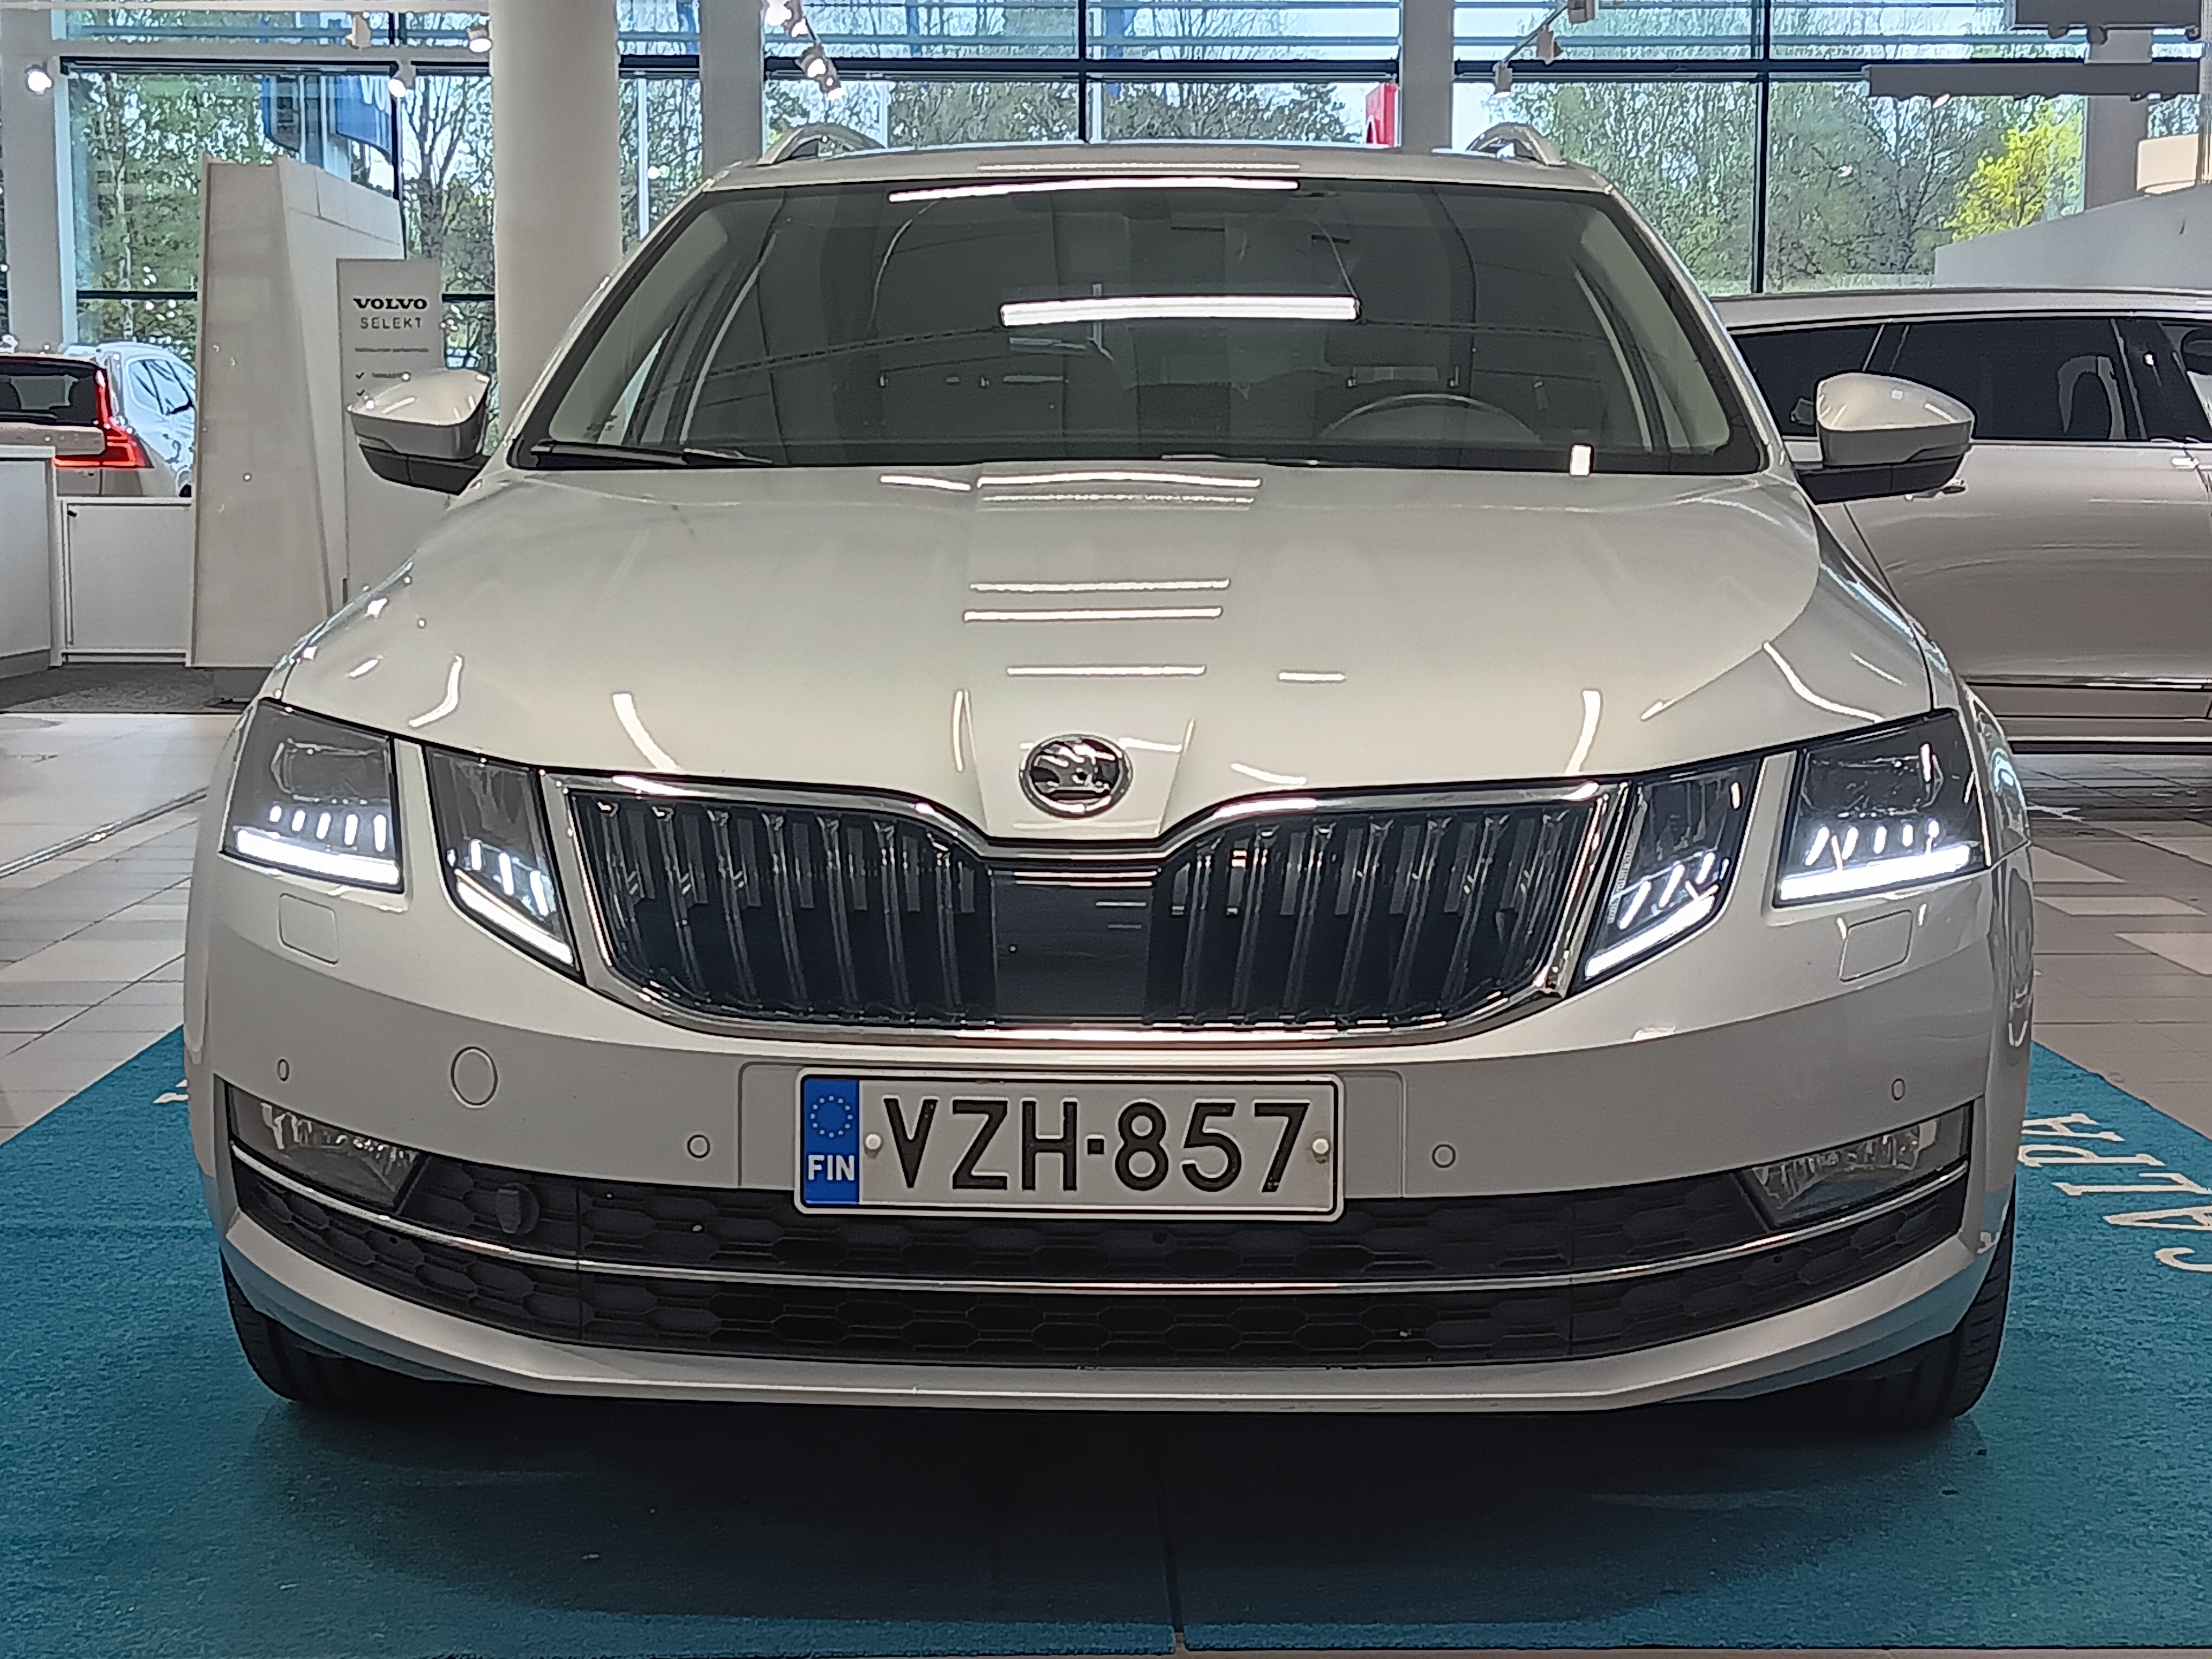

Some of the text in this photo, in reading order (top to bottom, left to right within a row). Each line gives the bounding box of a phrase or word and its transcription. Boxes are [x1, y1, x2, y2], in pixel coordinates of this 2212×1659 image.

[353, 298, 427, 310] VOLVO
[360, 317, 421, 329] SELEKT
[883, 1097, 1311, 1193] VZH-857
[807, 1154, 855, 1181] FIN
